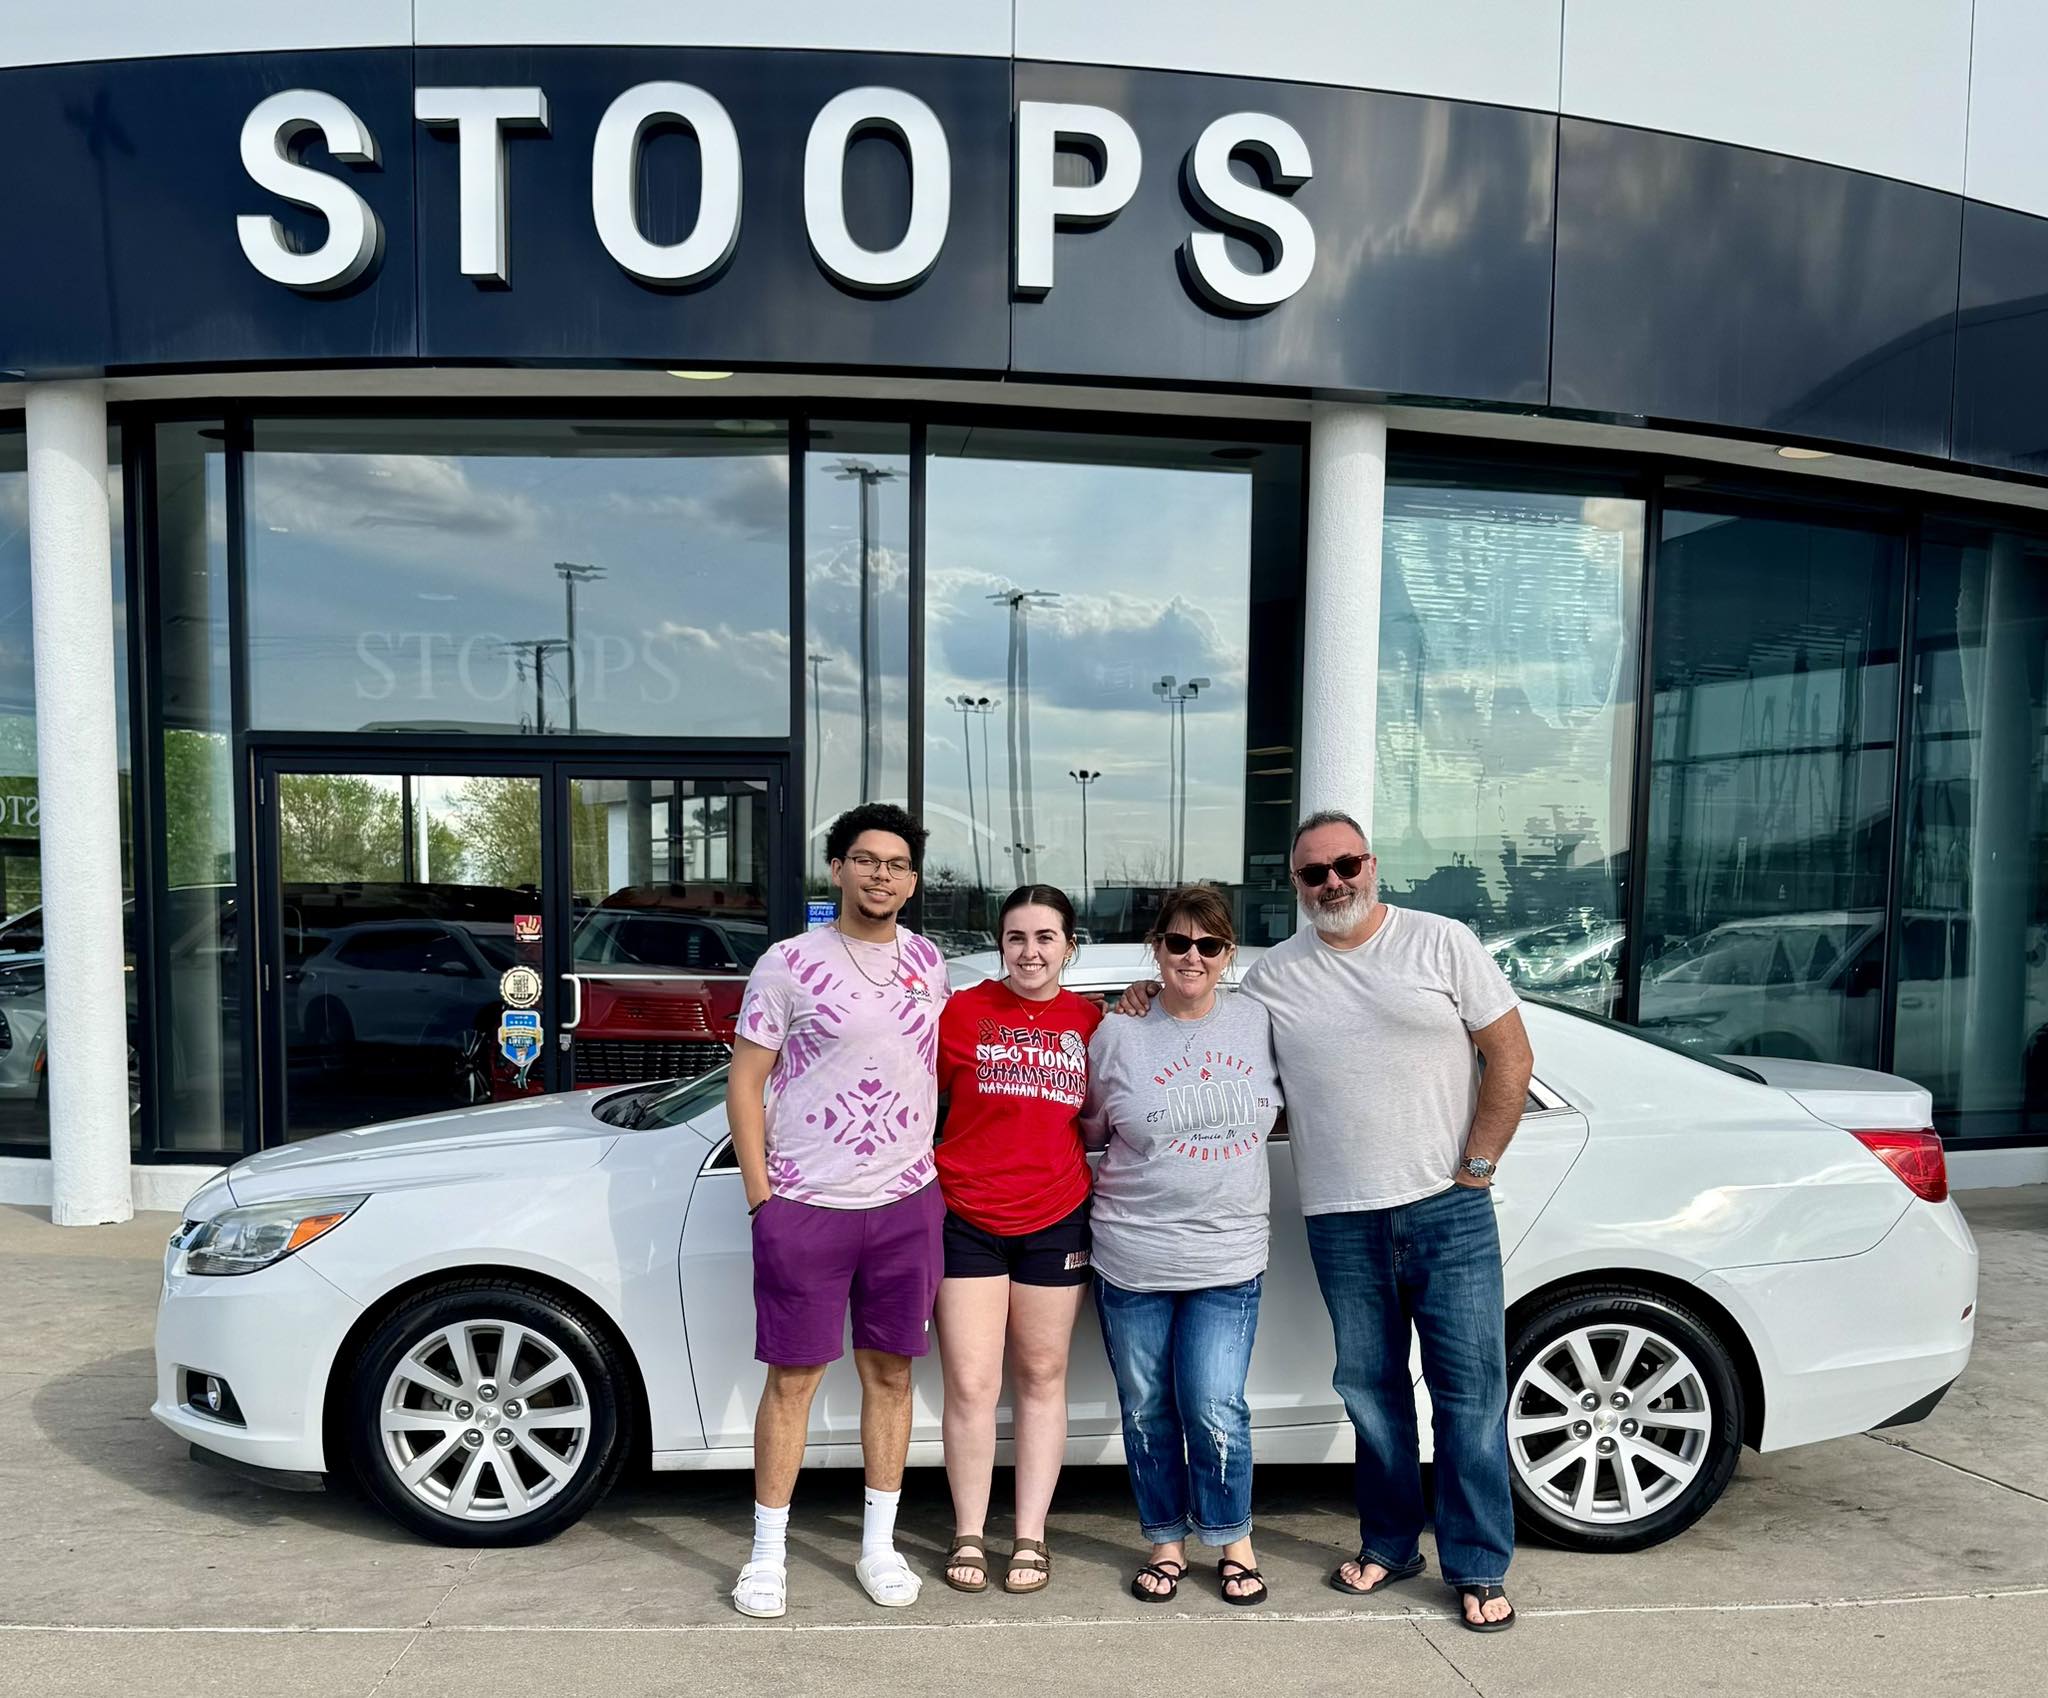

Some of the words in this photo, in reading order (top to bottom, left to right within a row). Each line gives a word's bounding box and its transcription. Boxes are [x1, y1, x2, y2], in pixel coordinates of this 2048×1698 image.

[236, 80, 1317, 314] STOOPS
[354, 630, 681, 705] STOOPS
[999, 1025, 1058, 1050] PEAT
[976, 1062, 1087, 1097] CHAMPIONS
[1153, 1056, 1192, 1087] BALL
[1205, 1050, 1255, 1077] STATE
[978, 1081, 1039, 1098] WAPAHANI
[1166, 1079, 1257, 1134] MOM
